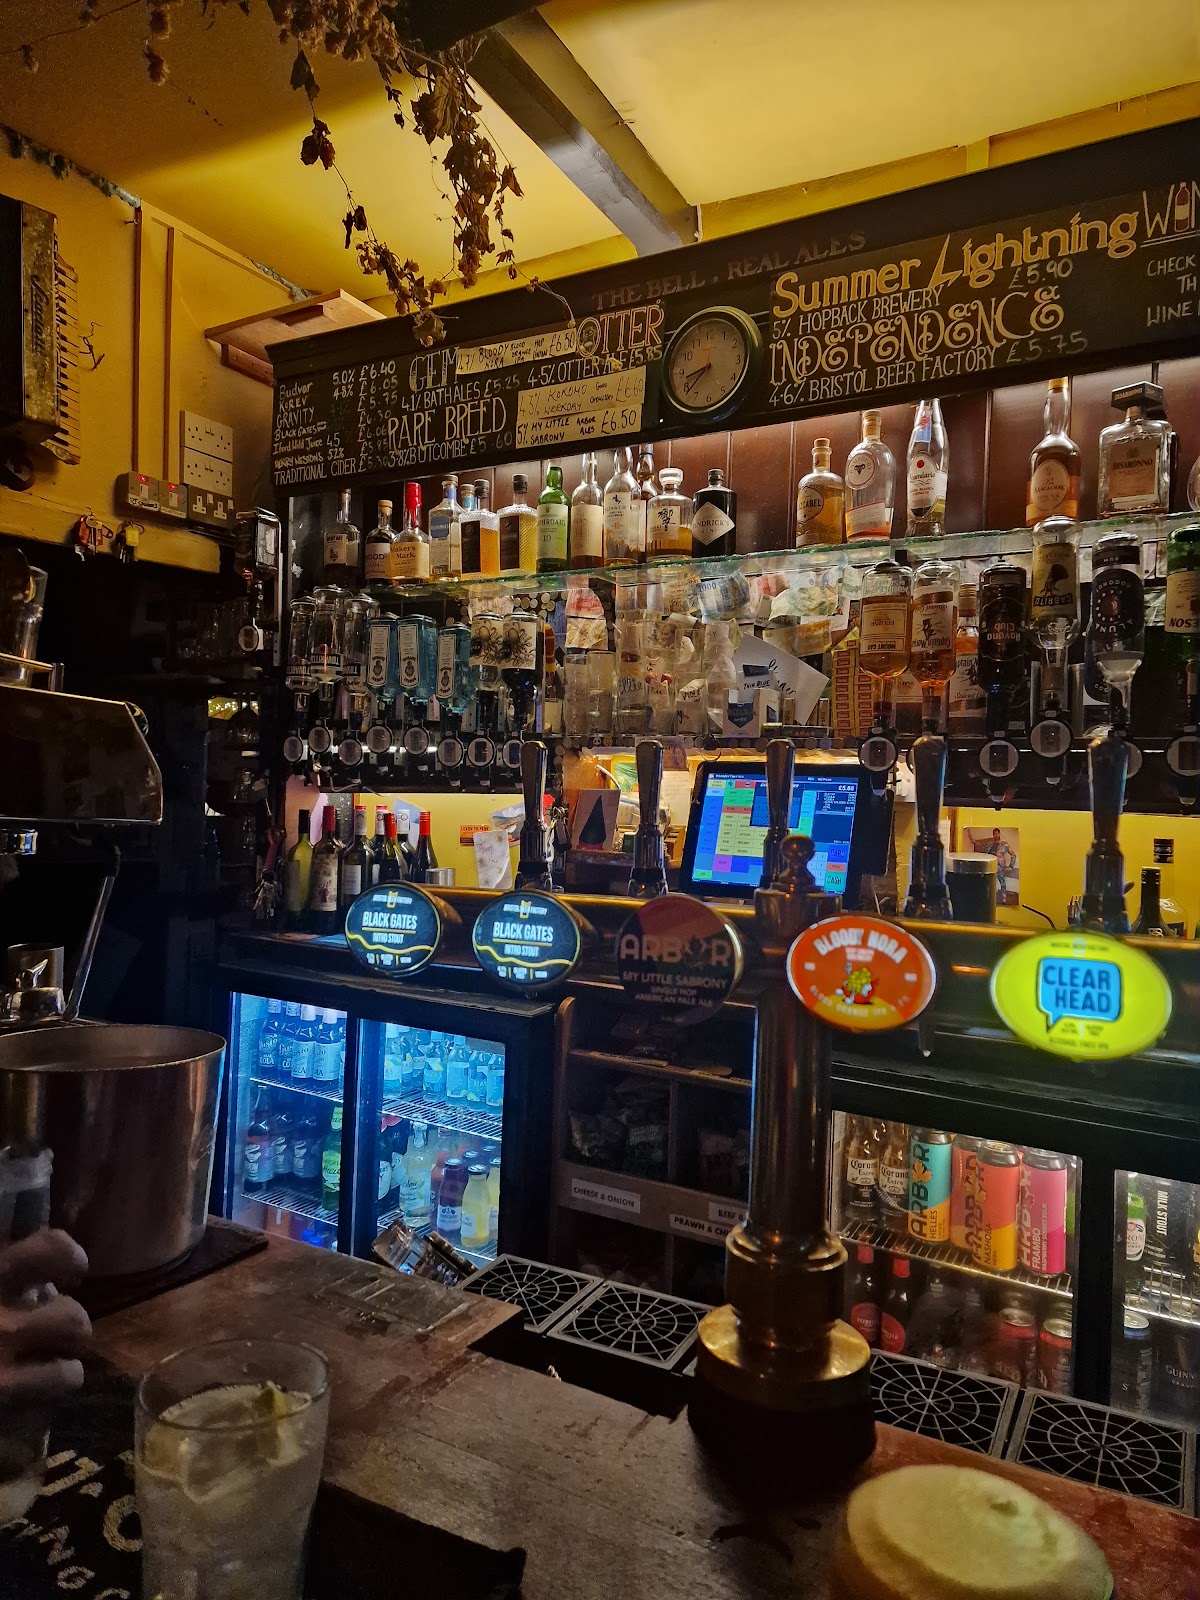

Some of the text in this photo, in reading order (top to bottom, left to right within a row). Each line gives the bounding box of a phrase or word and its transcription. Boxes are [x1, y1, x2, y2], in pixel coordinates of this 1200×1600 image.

[592, 232, 866, 310] THE BELL REAL ALES
[773, 211, 1140, 318] Summer Lightning
[1147, 254, 1197, 277] CHECK
[772, 258, 1074, 340] 5% HOPBACK BREWERY £5.90
[1146, 301, 1194, 327] WINE
[576, 304, 665, 358] OTTER
[769, 286, 1066, 386] INDEPENDENCE
[479, 344, 509, 363] BLOODY
[732, 338, 738, 349] 2
[485, 357, 504, 369] NORA
[684, 351, 693, 362] 10
[736, 354, 741, 365] 3
[808, 369, 873, 402] BRISTOL
[876, 358, 916, 389] BEER
[921, 345, 998, 382] FACTORY
[1006, 330, 1089, 364] £5.75
[557, 358, 601, 382] OTTER
[679, 368, 685, 379] 9
[731, 372, 736, 381] 4
[279, 360, 396, 401] Budvar 5.0% £6.40
[683, 382, 690, 393] 8
[333, 384, 354, 401] 4.8%
[548, 385, 588, 402] KOKOMO
[693, 391, 699, 401] 7
[706, 393, 712, 402] 6
[720, 386, 726, 396] 5
[276, 407, 315, 430] GRAVITY
[545, 403, 582, 416] WEEKDAY
[388, 396, 507, 453] RARE BREED
[532, 422, 543, 431] MY
[545, 417, 570, 429] LITTLE
[577, 416, 596, 425] ARBOR
[601, 410, 637, 435] £6.50
[531, 427, 595, 446] SABRONY ALES
[409, 439, 467, 465] BUTCOMBE
[274, 463, 328, 485] TRADITIONAL
[331, 458, 357, 477] CIDER
[987, 631, 1021, 642] Havana
[994, 622, 1015, 631] Club
[827, 876, 842, 885] CASH
[362, 911, 418, 930] BLACK GATES
[493, 922, 553, 942] BLACK GATES
[813, 928, 864, 956] BLOODY
[867, 930, 908, 964] NORA
[1043, 965, 1111, 991] CLEAR
[1055, 988, 1112, 1013] HEAD
[881, 1167, 909, 1179] Corona
[573, 1186, 599, 1199] CHEESE
[607, 1195, 635, 1207] ONION
[674, 1216, 705, 1230] PRAWN
[1156, 1190, 1169, 1236] MILK STOUT
[930, 1209, 938, 1239] HELLES
[1032, 1227, 1041, 1269] FRAMBO
